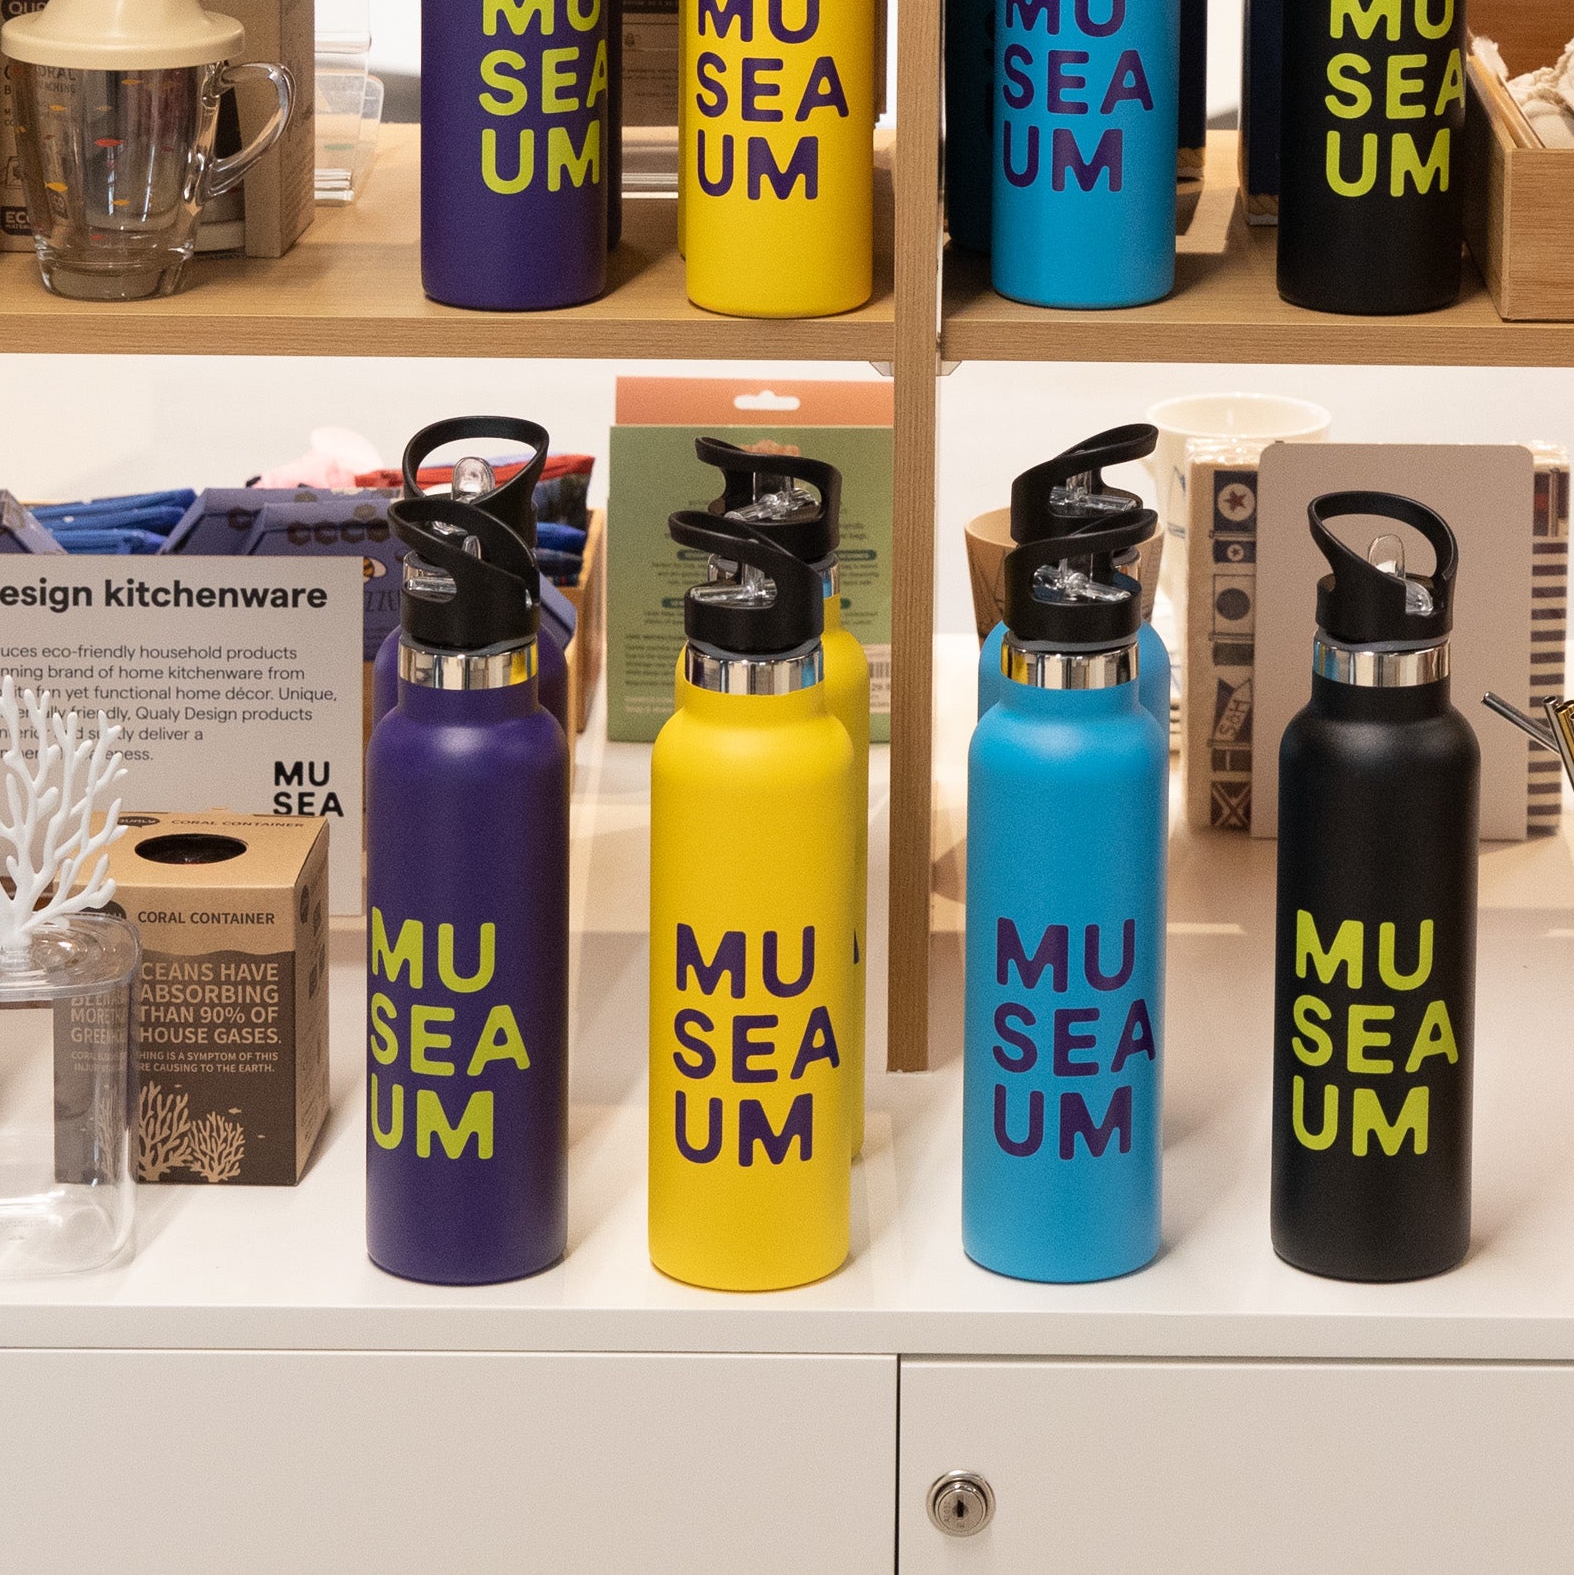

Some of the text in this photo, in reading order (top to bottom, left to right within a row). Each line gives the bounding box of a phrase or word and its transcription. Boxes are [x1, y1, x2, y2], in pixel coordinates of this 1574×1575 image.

[478, 39, 607, 117] SEA
[696, 51, 849, 123] SEA
[1002, 42, 1154, 116] SEA
[1324, 52, 1466, 121] SEA
[480, 119, 601, 195] UM
[697, 129, 819, 201] UM
[1002, 121, 1123, 193] UM
[1325, 128, 1451, 198] UM
[104, 578, 329, 609] kitchenware
[41, 644, 136, 661] eco-friendly
[140, 645, 223, 660] household
[226, 646, 298, 663] products
[48, 665, 94, 679] brand
[98, 665, 114, 679] of
[119, 665, 164, 679] home
[168, 666, 263, 681] kitchenware
[268, 666, 305, 681] from
[65, 685, 90, 701] yet
[94, 686, 171, 701] functional
[176, 687, 221, 701] home
[225, 687, 274, 701] décor.
[278, 687, 337, 703] Unique,
[136, 707, 180, 723] Qualy
[184, 707, 238, 724] Design
[242, 708, 313, 723] products
[138, 727, 190, 741] deliver
[273, 792, 344, 817] SEA
[274, 761, 330, 787] MU
[138, 910, 275, 925] CORAL CONTAINER
[371, 906, 495, 994] MU
[1295, 909, 1433, 990] MU
[220, 963, 279, 981] HAVE
[676, 923, 815, 999] MU
[996, 916, 1135, 993] MU
[140, 985, 279, 1004] ABSORBING
[140, 1006, 279, 1024] THAN 90% OF
[214, 1027, 282, 1044] GASES.
[370, 993, 530, 1077] SEA
[673, 1006, 840, 1084] SEA
[992, 998, 1156, 1077] SEA
[1292, 994, 1459, 1074] SEA
[371, 1072, 494, 1160] UM
[675, 1090, 813, 1167] UM
[994, 1083, 1132, 1161] UM
[1292, 1074, 1430, 1157] UM
